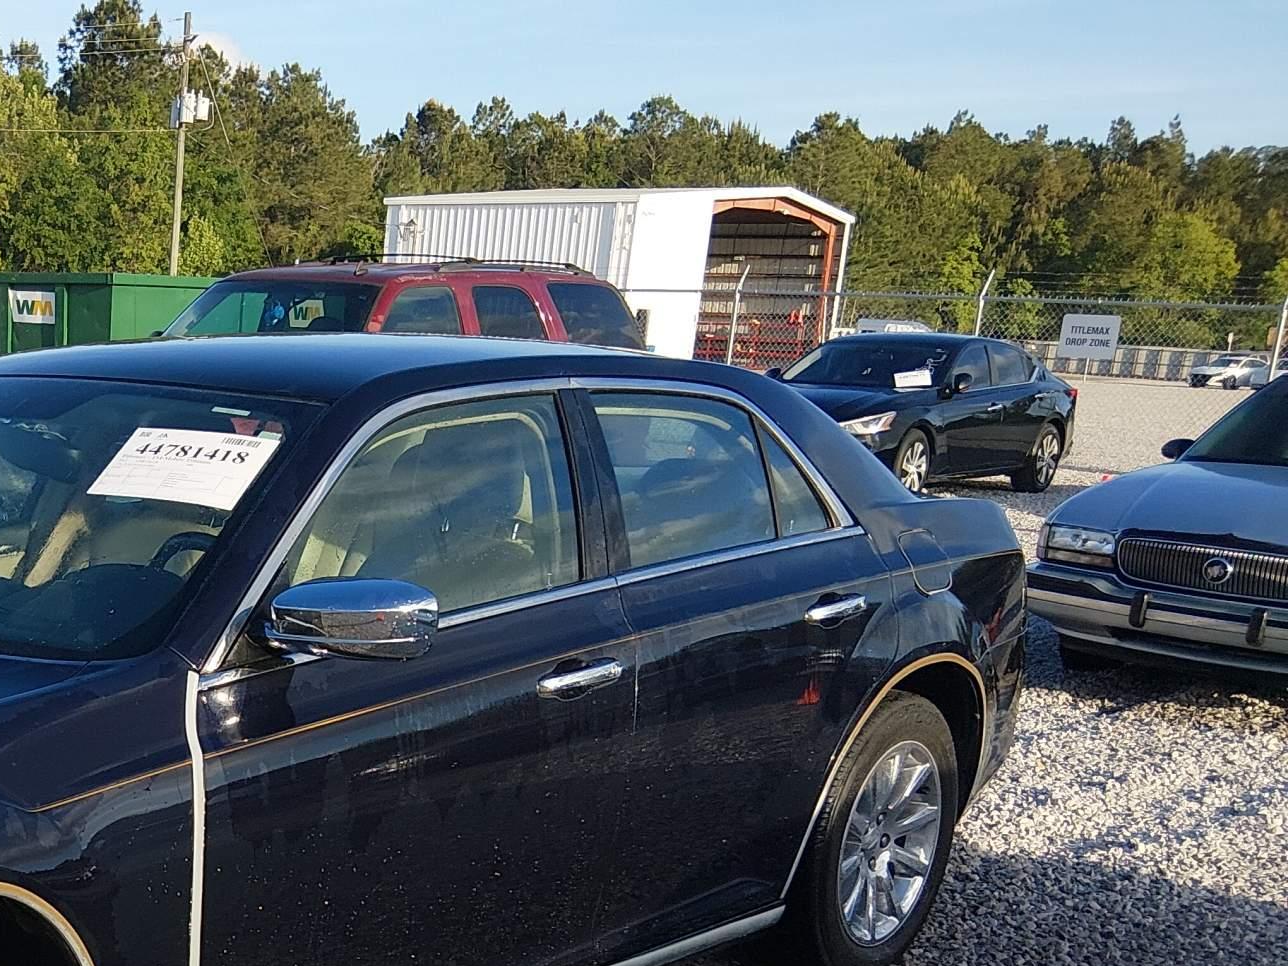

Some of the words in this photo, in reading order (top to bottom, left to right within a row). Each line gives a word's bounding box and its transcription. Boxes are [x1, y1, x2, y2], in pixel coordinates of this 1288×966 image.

[15, 299, 54, 317] WM
[1070, 325, 1111, 335] TITLEMAX
[1065, 337, 1088, 346] DROP
[1088, 338, 1111, 348] ZONE
[135, 442, 250, 465] 44781418
